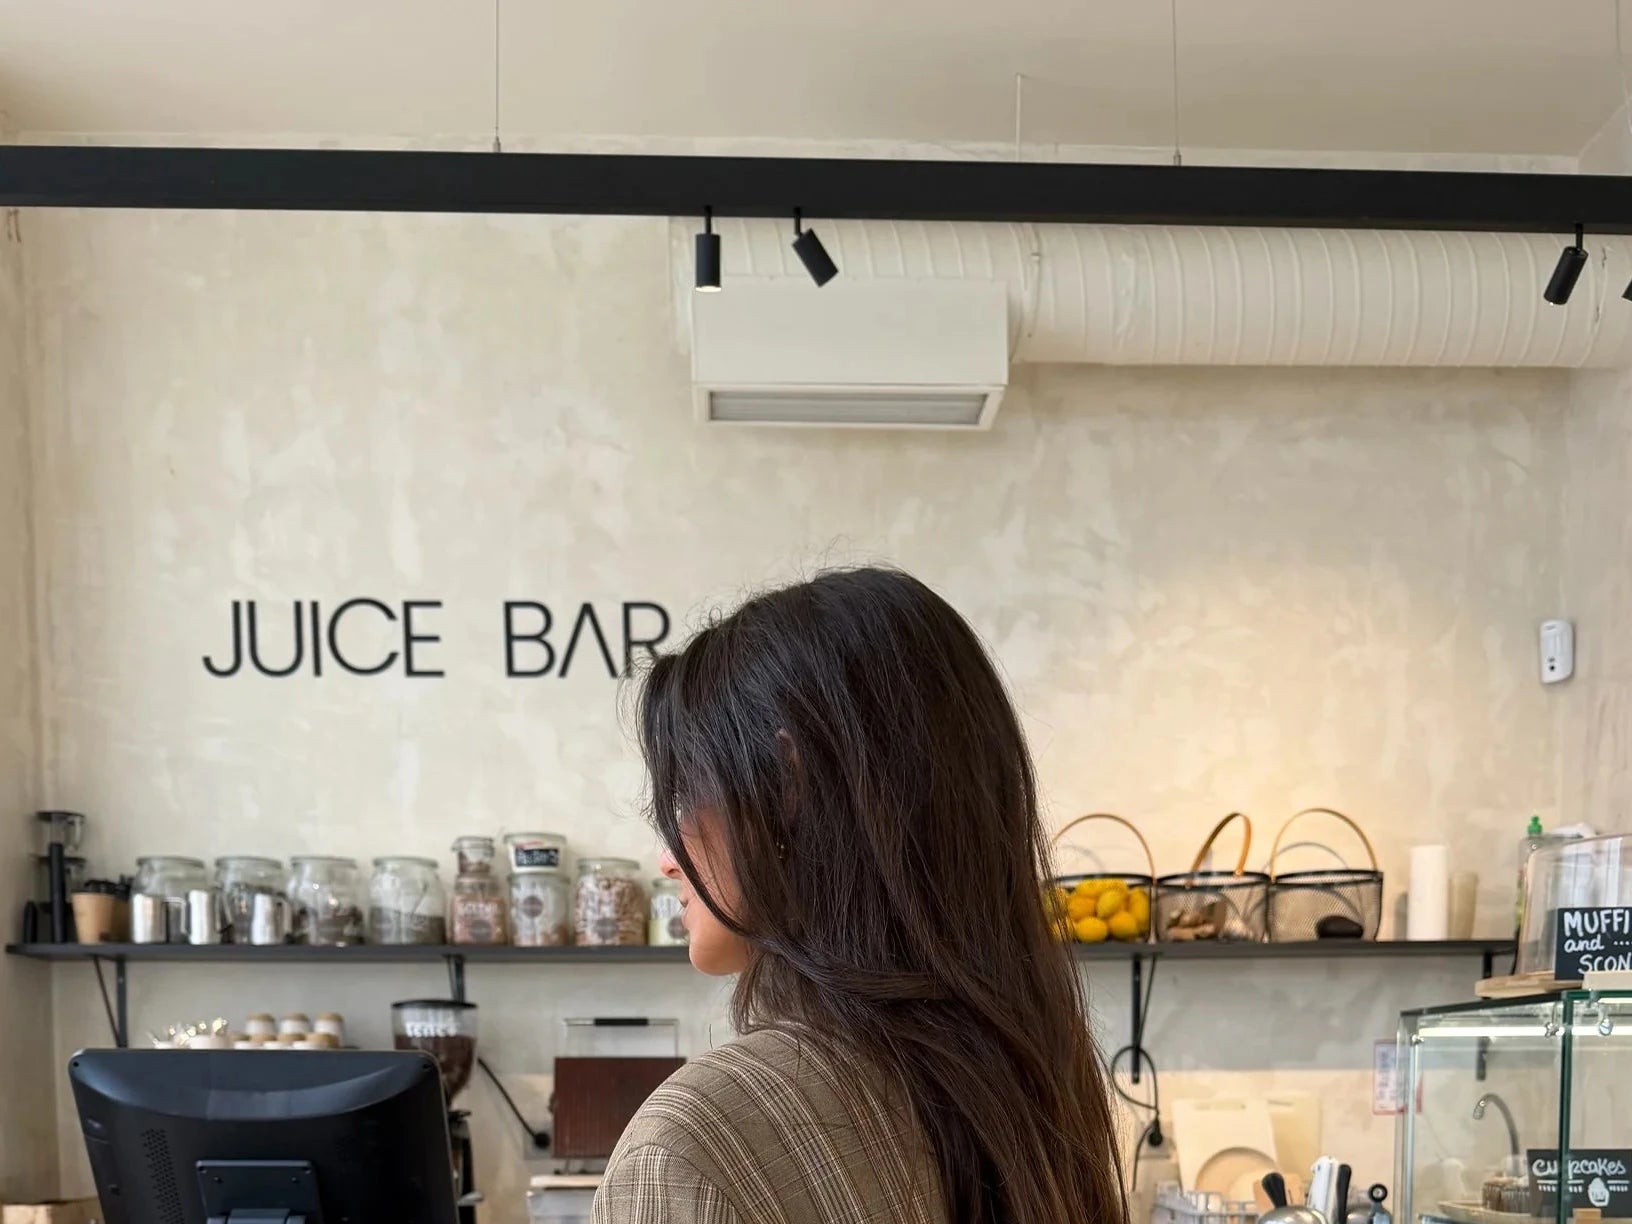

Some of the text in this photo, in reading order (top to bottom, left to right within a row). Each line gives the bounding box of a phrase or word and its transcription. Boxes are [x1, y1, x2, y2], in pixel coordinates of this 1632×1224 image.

[202, 597, 671, 679] JUICE BAR
[1564, 934, 1605, 953] and
